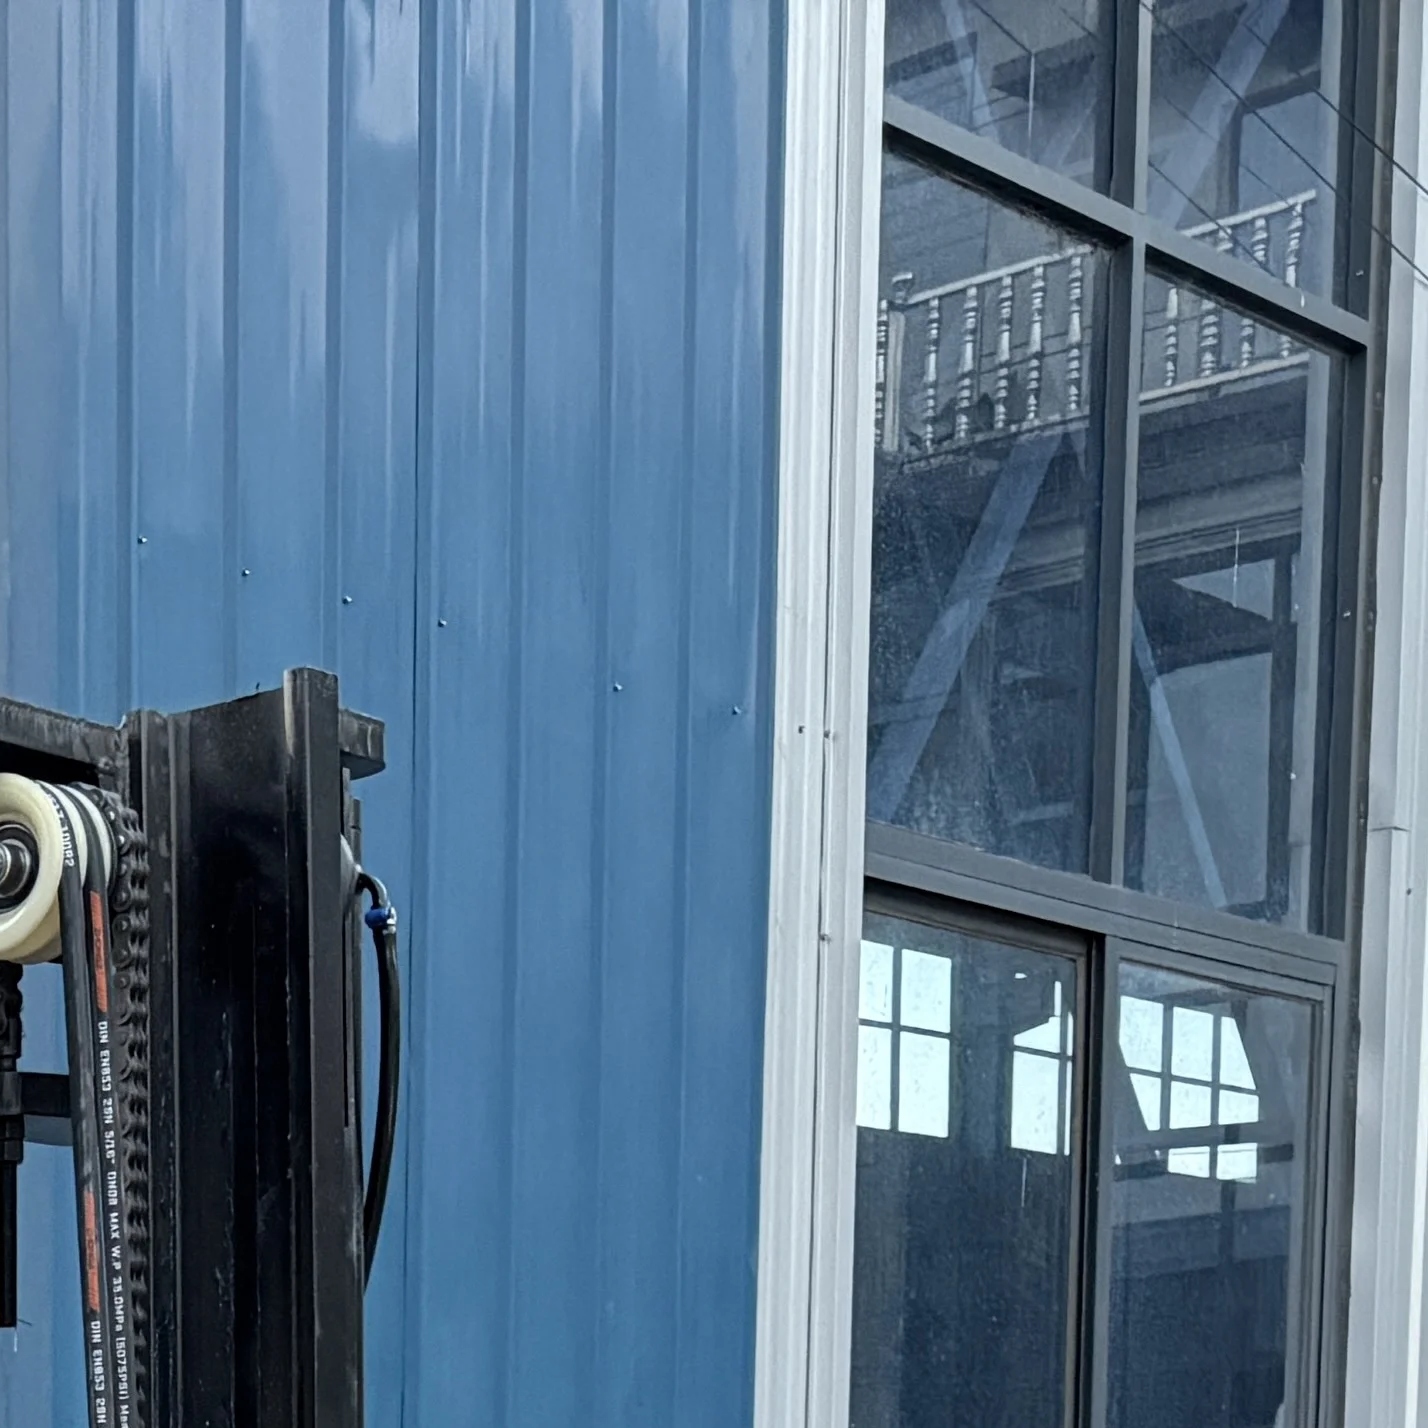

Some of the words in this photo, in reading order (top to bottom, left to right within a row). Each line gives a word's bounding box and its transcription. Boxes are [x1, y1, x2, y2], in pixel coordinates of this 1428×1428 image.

[99, 1021, 108, 1043] DIN
[110, 1213, 121, 1239] MAX
[91, 1321, 101, 1342] DIN
